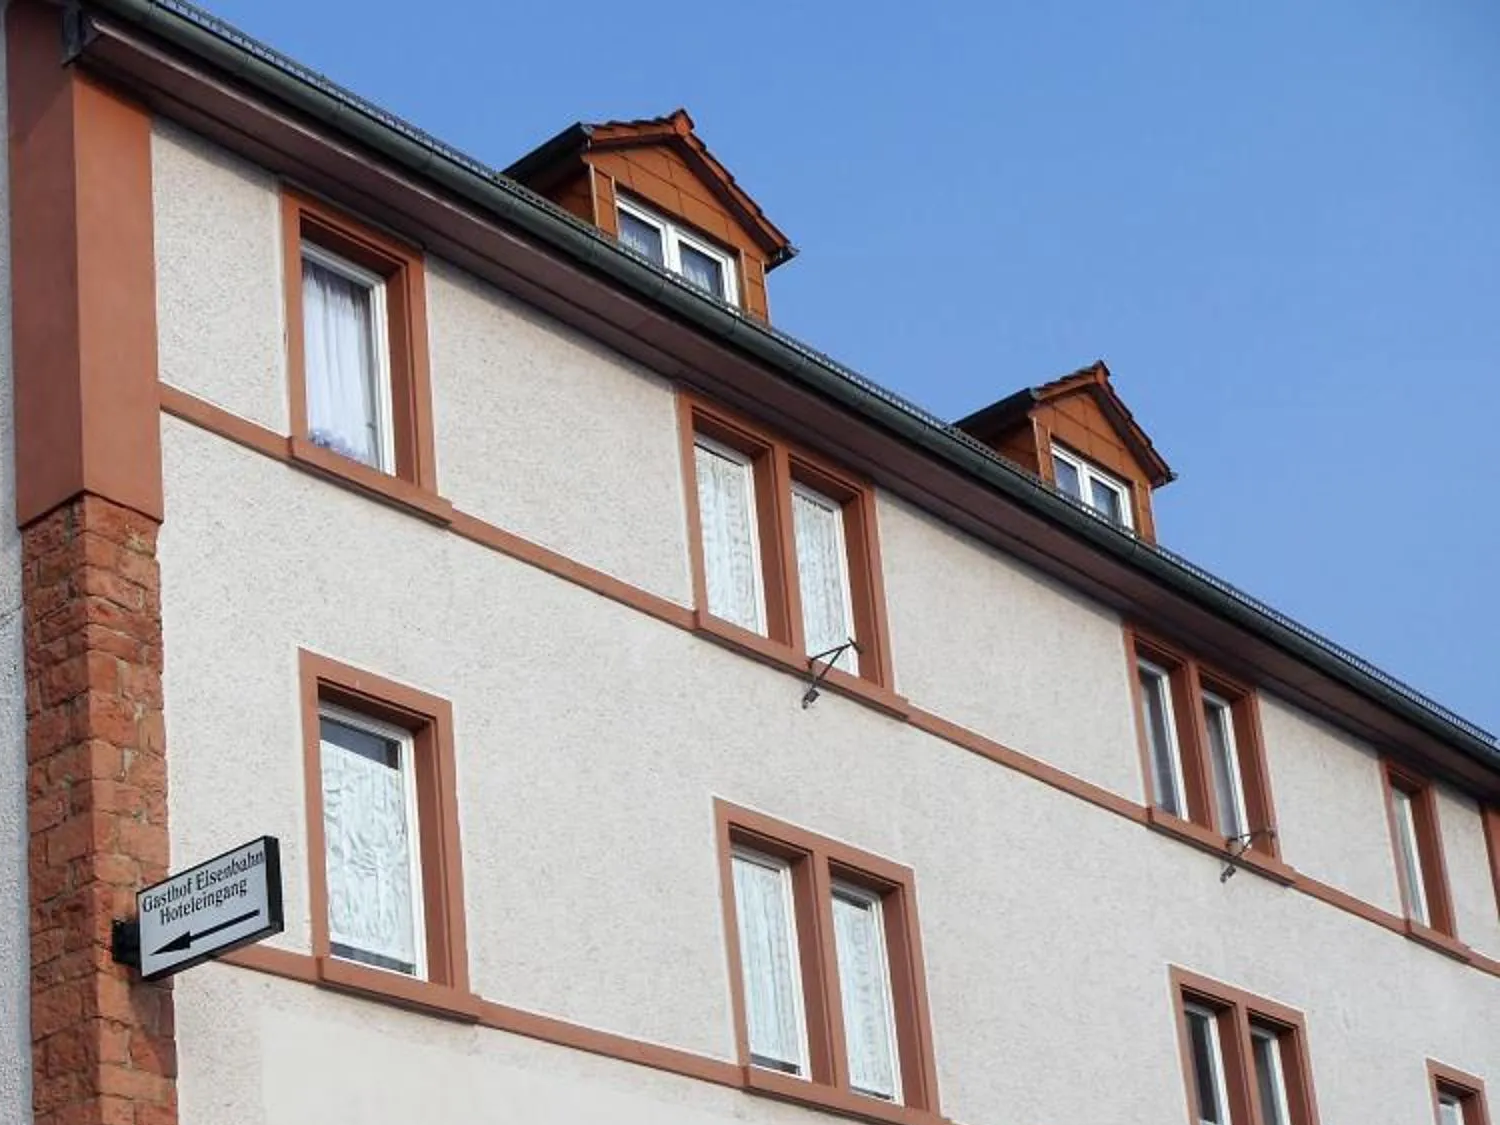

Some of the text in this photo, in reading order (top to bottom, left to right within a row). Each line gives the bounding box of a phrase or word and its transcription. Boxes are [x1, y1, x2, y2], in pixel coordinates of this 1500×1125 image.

[142, 850, 265, 913] Gasthof Eisenbahn
[160, 878, 248, 926] Hoteleingang
